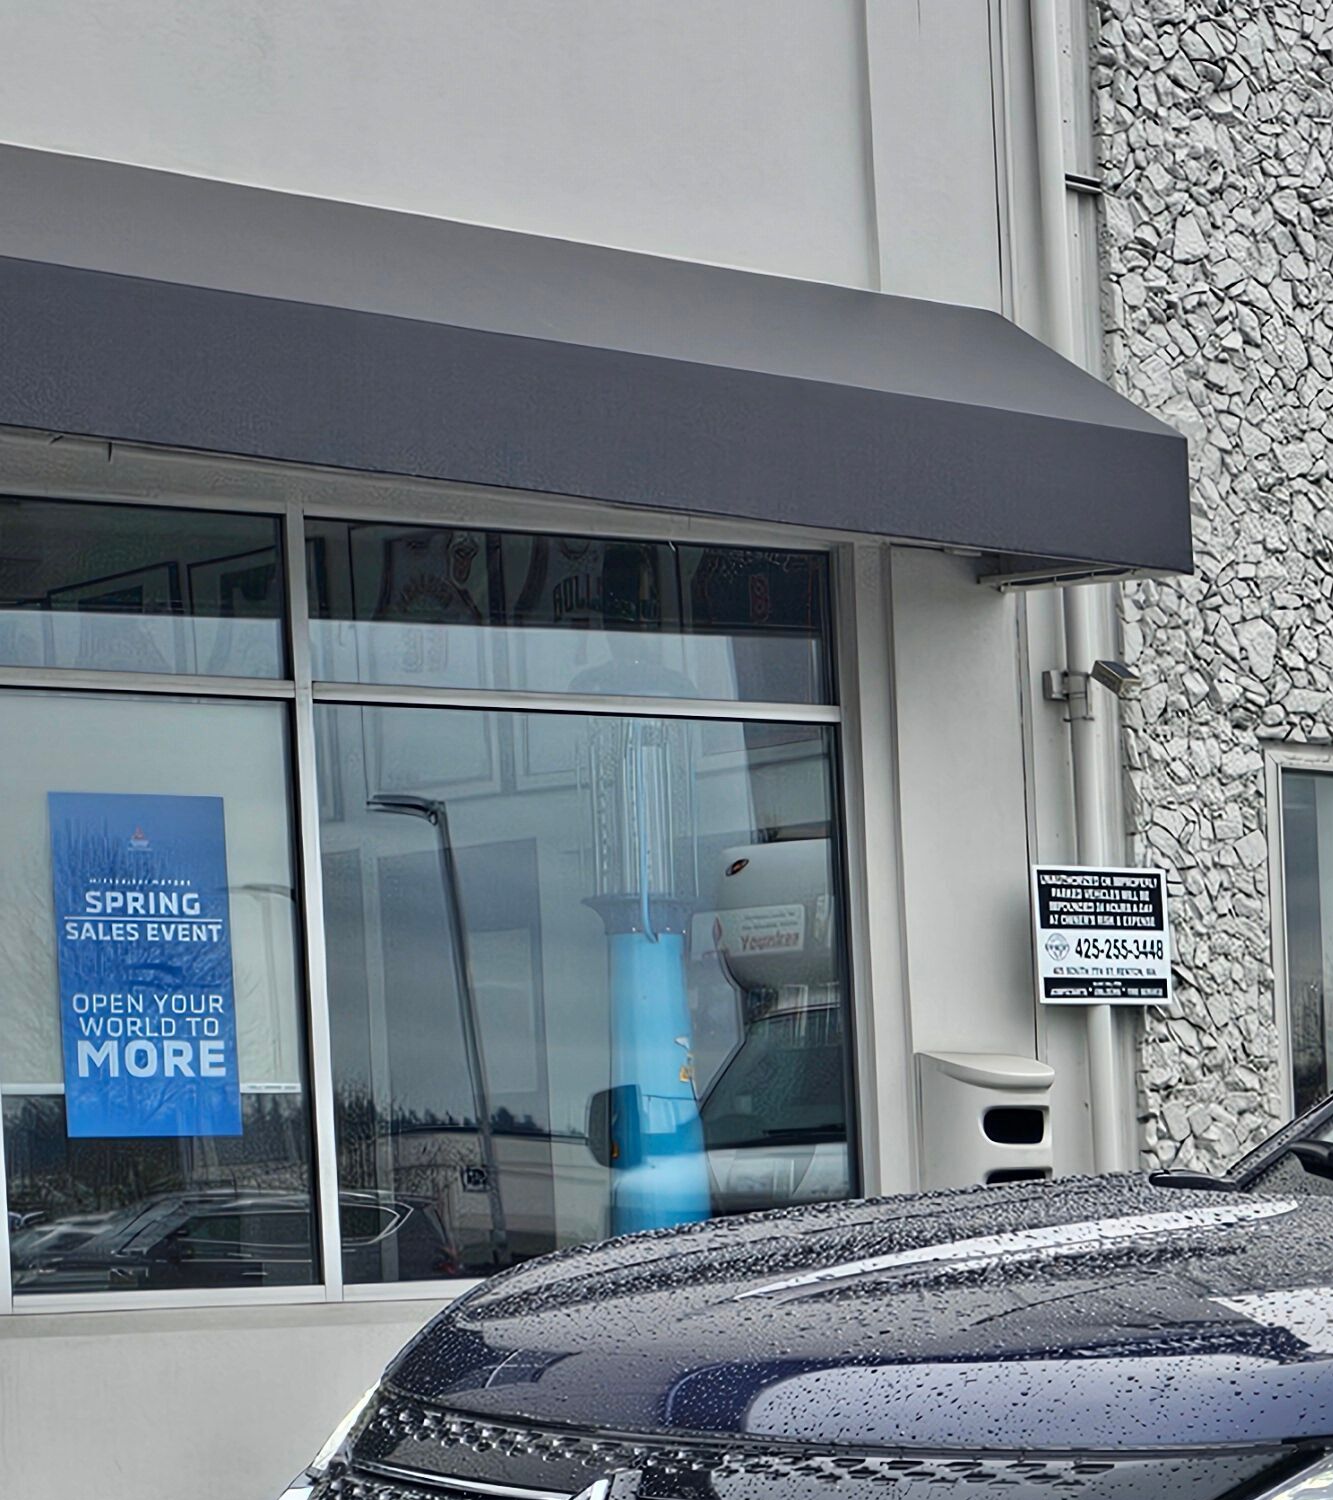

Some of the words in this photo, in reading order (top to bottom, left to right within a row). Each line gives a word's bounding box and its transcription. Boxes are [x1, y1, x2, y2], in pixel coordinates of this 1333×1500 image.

[85, 890, 201, 916] SPRING
[65, 921, 140, 942] SALES
[147, 922, 222, 943] EVENT
[1075, 937, 1165, 961] 425-255-3448
[72, 993, 143, 1014] OPEN
[154, 993, 225, 1014] YOUR
[79, 1016, 177, 1038] WORLD
[186, 1016, 220, 1038] TO
[77, 1039, 227, 1079] MORE
